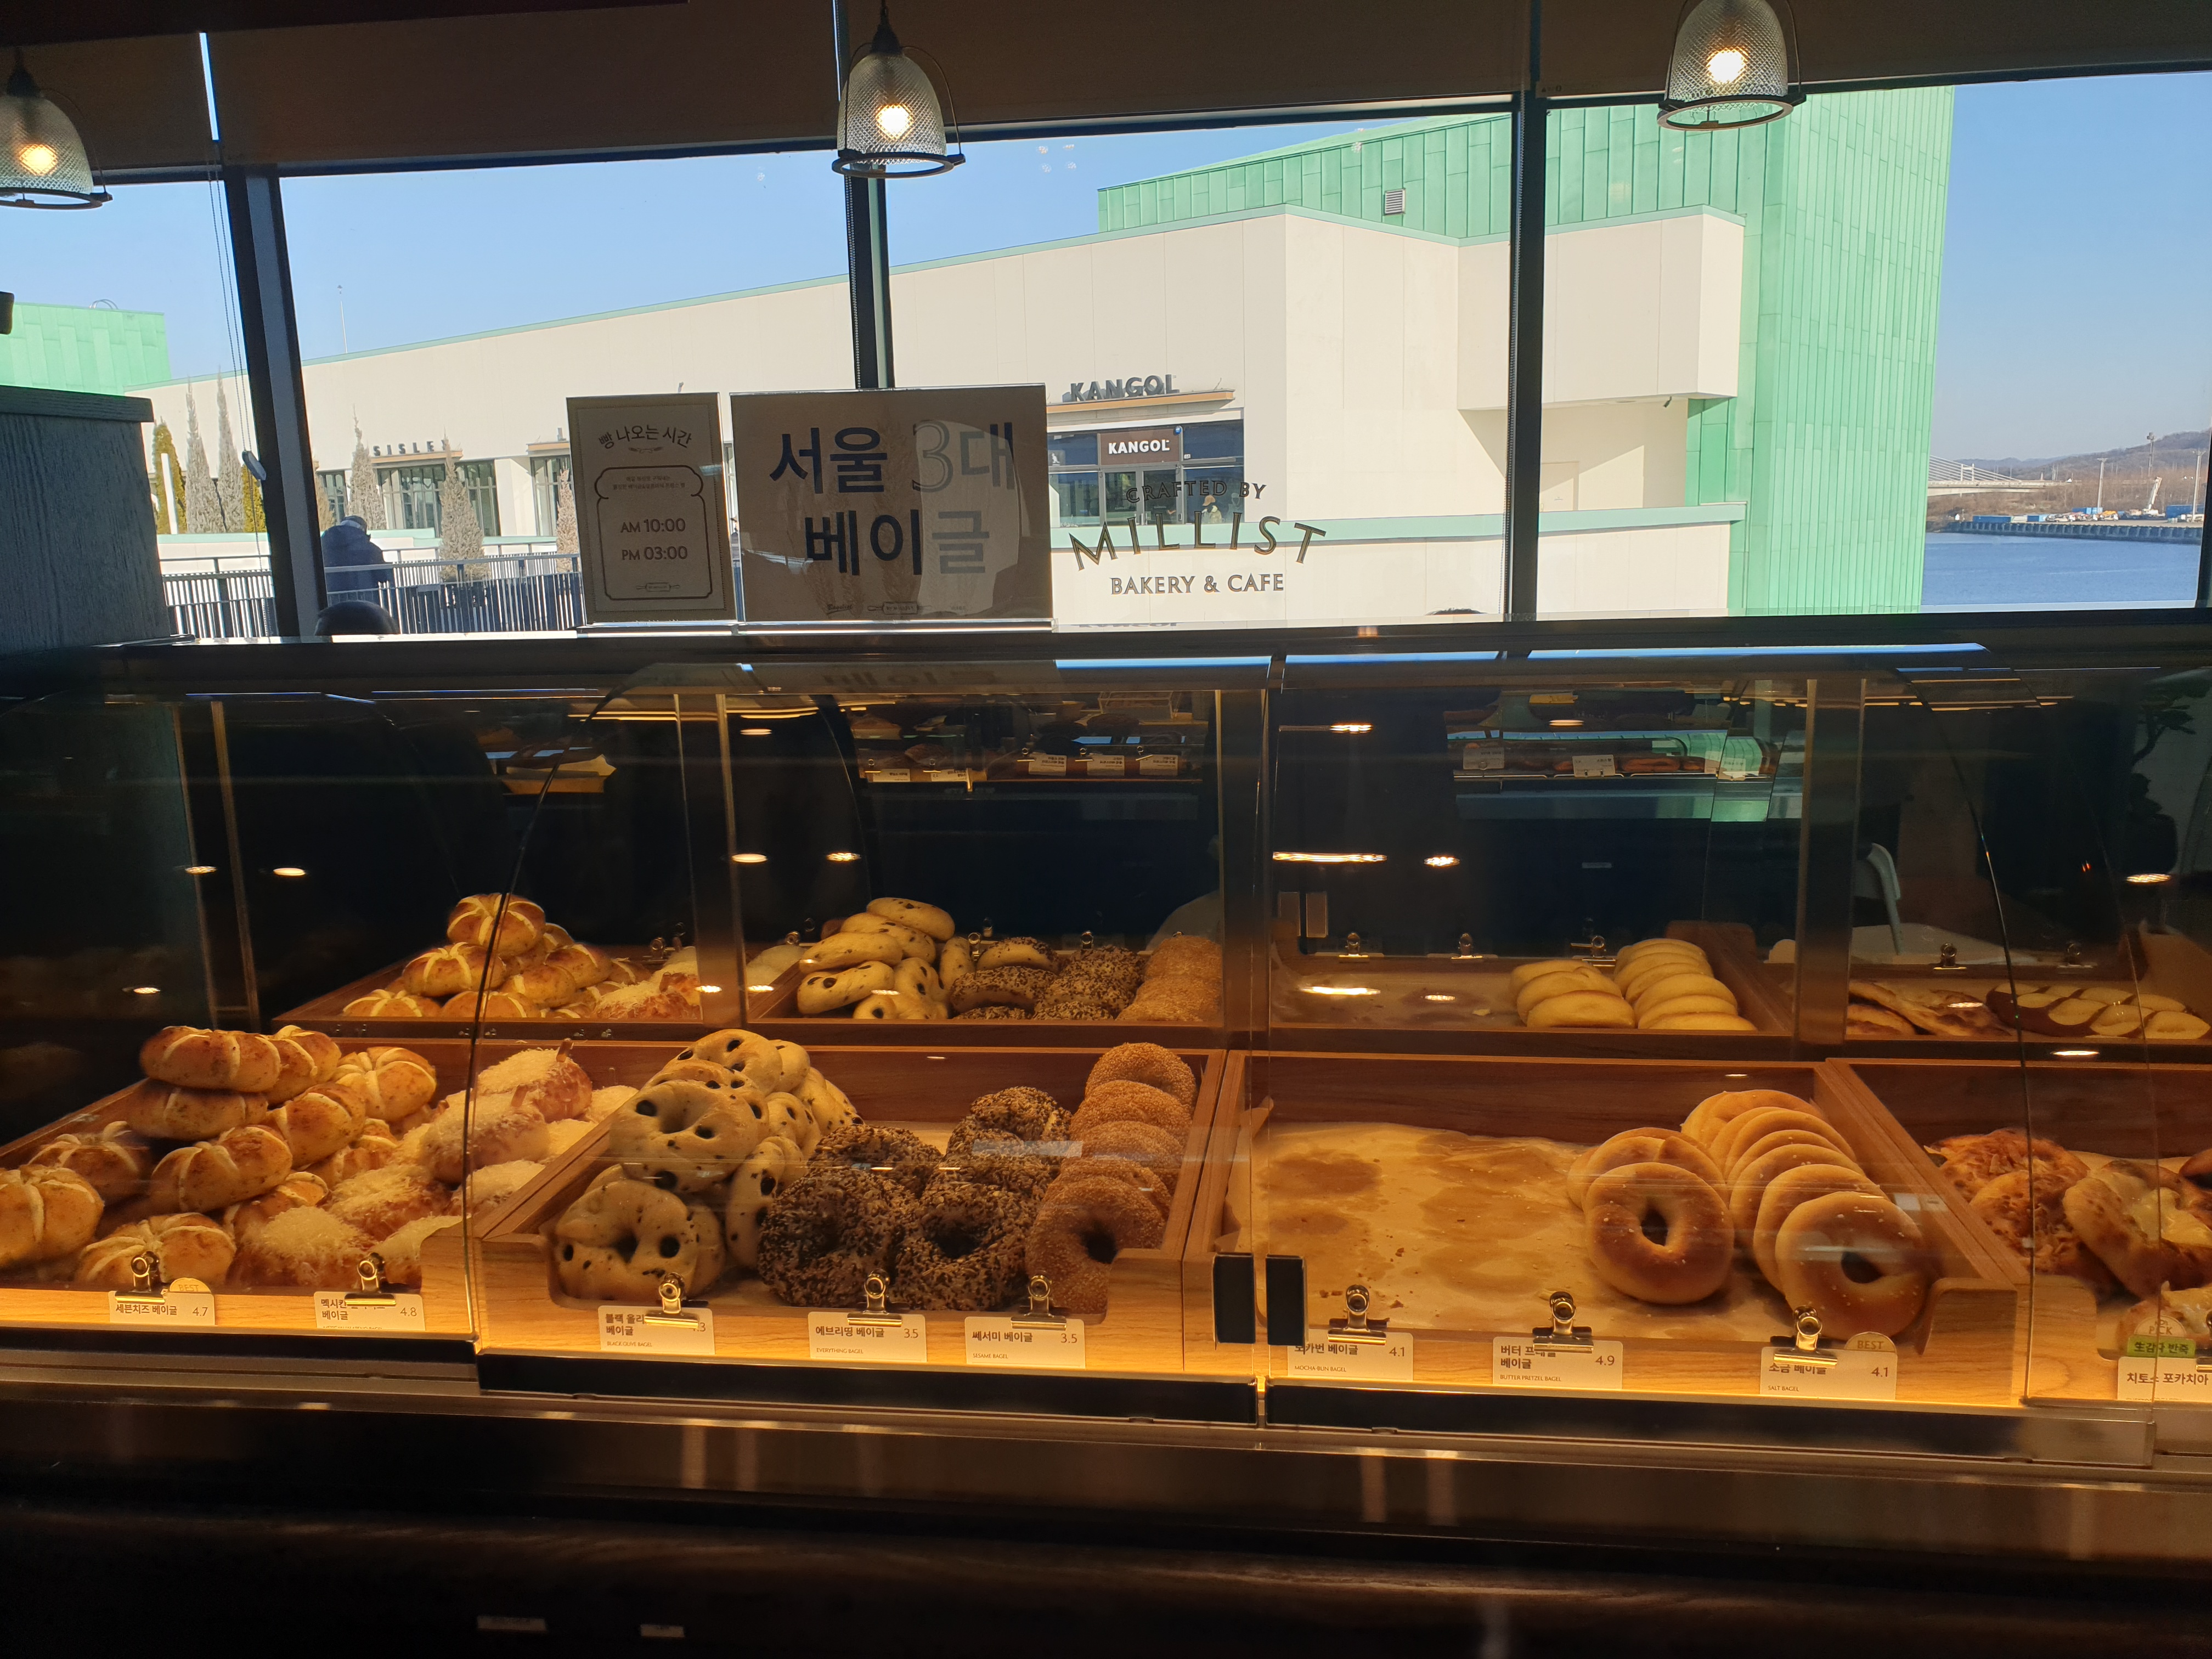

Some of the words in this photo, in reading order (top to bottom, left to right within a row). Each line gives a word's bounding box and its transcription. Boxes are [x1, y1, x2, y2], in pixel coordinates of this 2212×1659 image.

[1070, 374, 1180, 402] KANGOL
[598, 432, 614, 449] 빵
[616, 425, 659, 442] 나오는
[663, 427, 692, 448] 시간
[1108, 438, 1171, 455] KANGOL
[770, 427, 888, 494] 서울
[912, 419, 1015, 492] 3대
[1126, 480, 1227, 503] CRAFTED
[1239, 482, 1267, 500] BY
[620, 522, 641, 533] AM
[644, 518, 686, 533] 10:00
[805, 509, 990, 577] 베이글
[1068, 510, 1327, 571] MILLIST
[622, 549, 640, 560] PM
[644, 546, 688, 560] 03:00
[1110, 575, 1195, 595] BAKERY
[1204, 575, 1220, 593] &
[1227, 573, 1284, 592] CAFE
[116, 1304, 150, 1314] 세븐치즈
[152, 1305, 177, 1316] 베이글
[192, 1307, 208, 1317] 4.7
[400, 1307, 417, 1317] 4.8
[322, 1311, 349, 1321] 베이글
[606, 1313, 624, 1324] 블랙
[627, 1314, 645, 1324] 올리
[606, 1325, 634, 1336] 베이글
[693, 1322, 706, 1332] .3
[816, 1325, 853, 1336] 에브리띵
[856, 1327, 885, 1338] 베이글
[2148, 1325, 2172, 1335] PCK
[904, 1328, 918, 1339] 3.5
[1004, 1331, 1033, 1342] 베이글
[1060, 1333, 1078, 1344] 3.5
[1328, 1344, 1358, 1355] 베이글
[1500, 1345, 1521, 1356] 버터
[1857, 1340, 1884, 1350] BEST
[2168, 1343, 2189, 1355] 반죽
[1389, 1346, 1405, 1357] 4.1
[1500, 1358, 1532, 1369] 베이글
[1595, 1355, 1615, 1366] 4.9
[1769, 1363, 1791, 1374] 소금
[1794, 1364, 1827, 1375] 베이글
[1871, 1367, 1888, 1377] 4.1
[2127, 1372, 2159, 1384] 치토스
[2163, 1373, 2209, 1386] 포카치아
